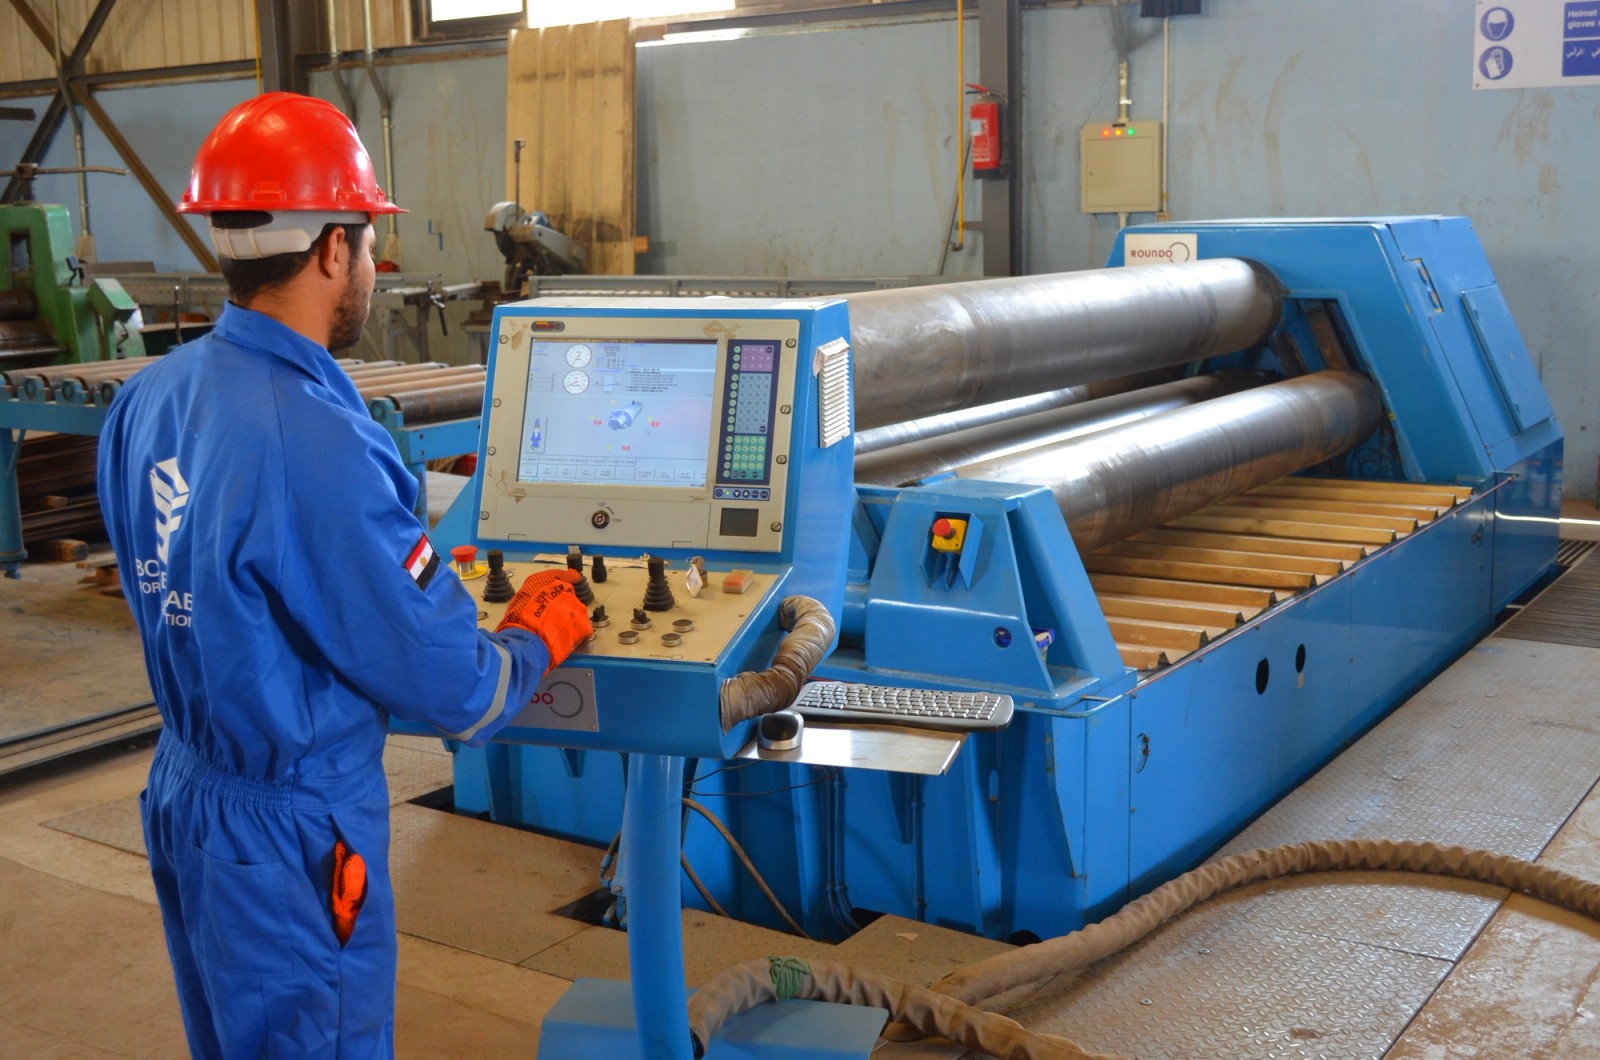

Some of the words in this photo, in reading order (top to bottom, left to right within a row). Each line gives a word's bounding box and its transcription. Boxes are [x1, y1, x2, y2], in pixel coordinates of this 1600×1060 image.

[1567, 9, 1597, 18] Helmet
[1567, 20, 1595, 30] gloves
[1130, 249, 1173, 258] ROUNDO
